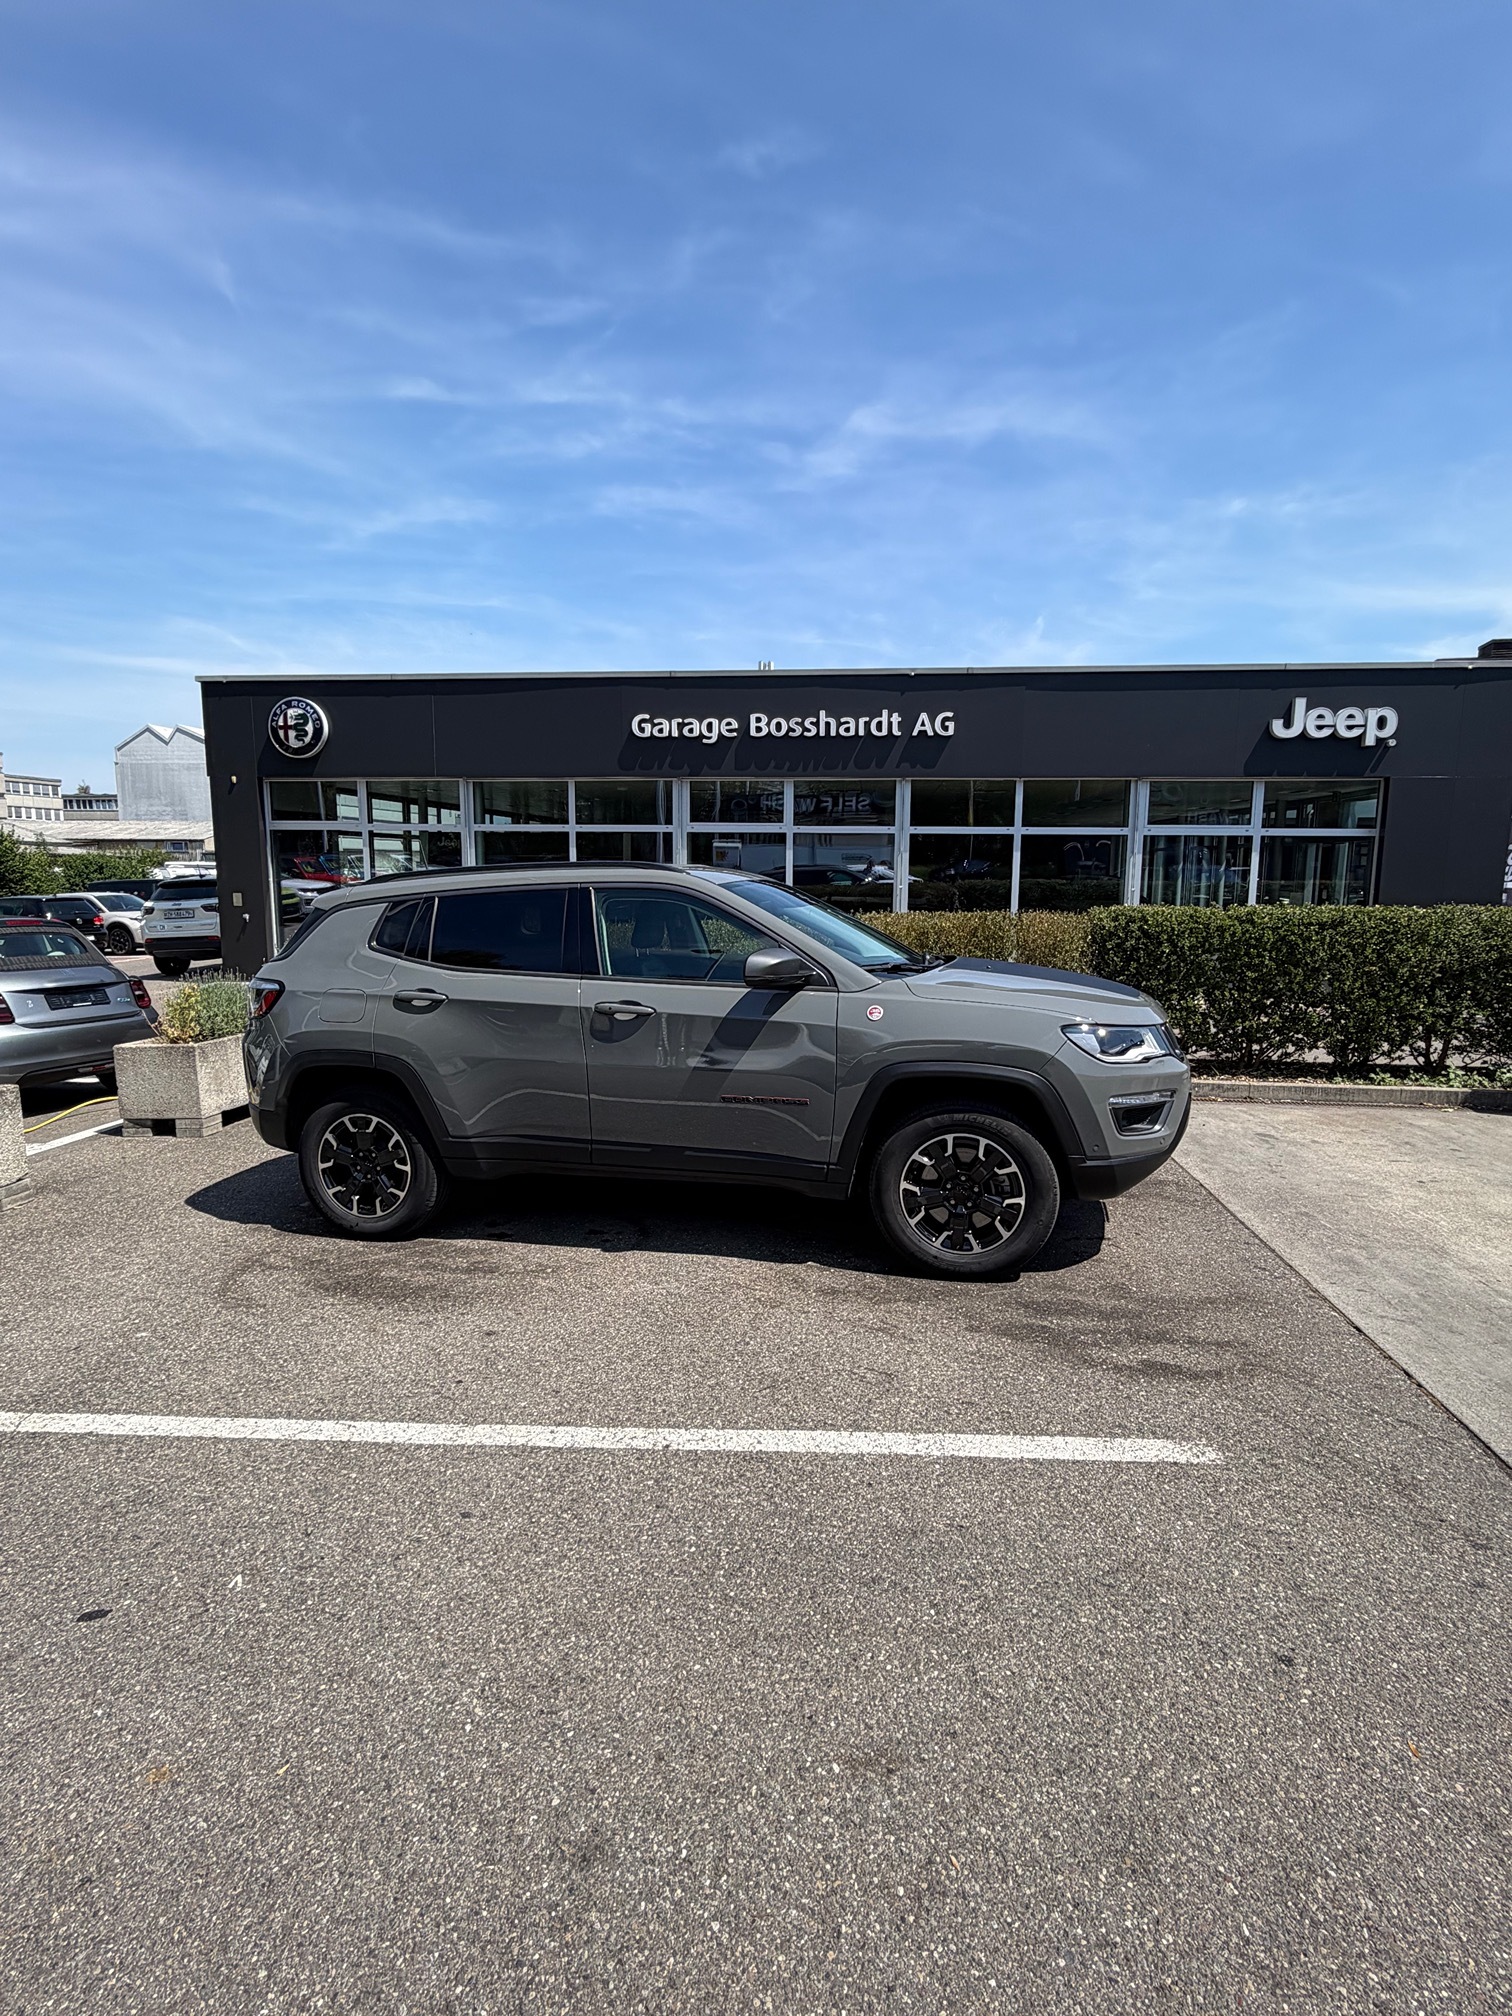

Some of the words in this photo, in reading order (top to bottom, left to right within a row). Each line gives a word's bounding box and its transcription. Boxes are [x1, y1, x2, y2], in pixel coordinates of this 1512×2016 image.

[271, 704, 288, 728] ALFA
[291, 700, 321, 729] ROMEO
[631, 713, 738, 744] Garage
[749, 709, 902, 738] Bosshardt
[911, 711, 956, 737] AG
[1269, 697, 1399, 747] Jeep
